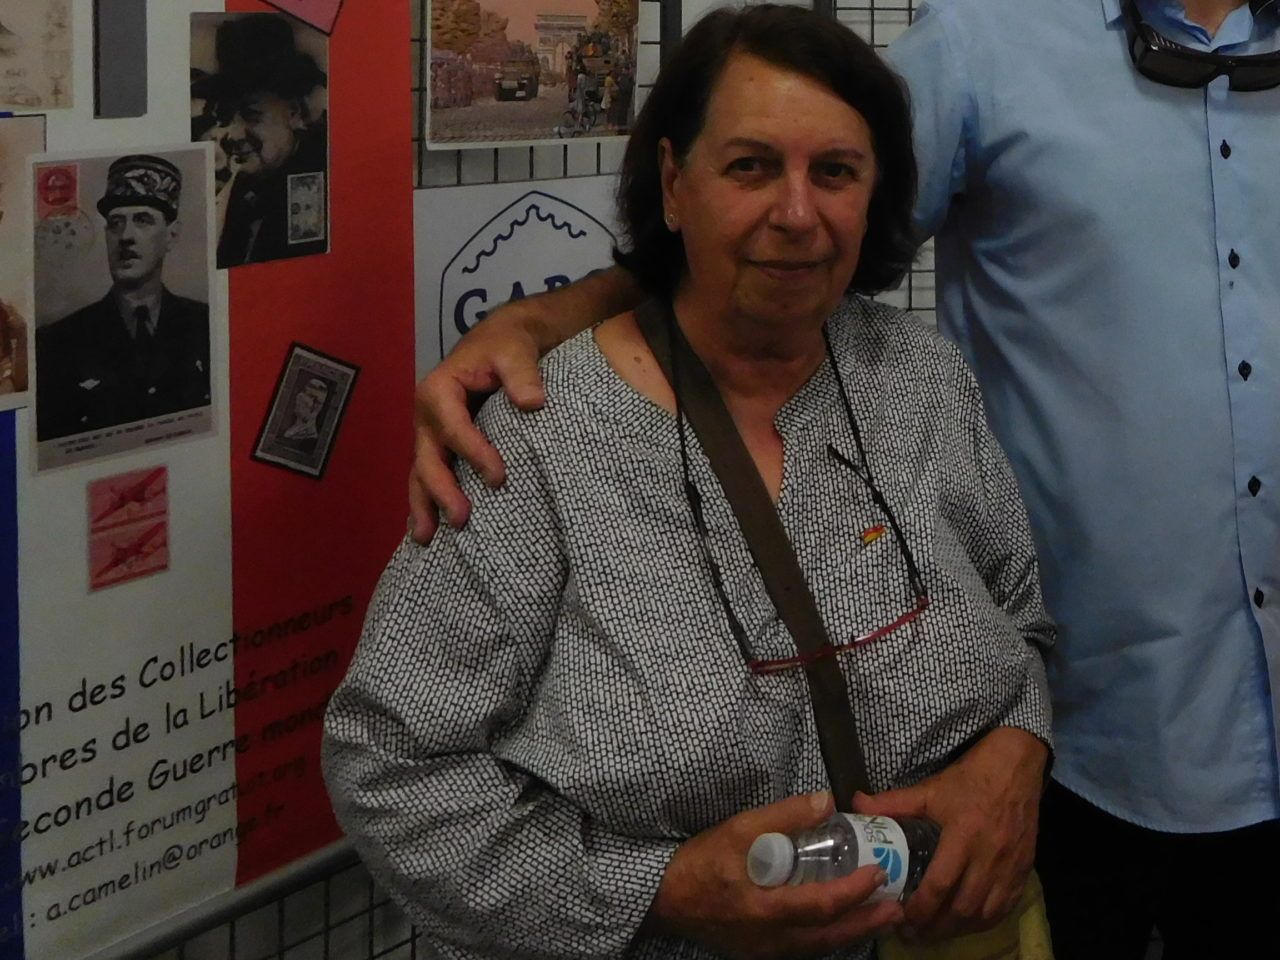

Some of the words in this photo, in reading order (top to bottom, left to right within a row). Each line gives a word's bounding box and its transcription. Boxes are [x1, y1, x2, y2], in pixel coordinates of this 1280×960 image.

[67, 677, 126, 715] des
[138, 595, 354, 688] Collectionneurs
[111, 717, 151, 753] de
[164, 702, 190, 734] la
[199, 647, 340, 721] Libération
[148, 735, 250, 792] Guerre
